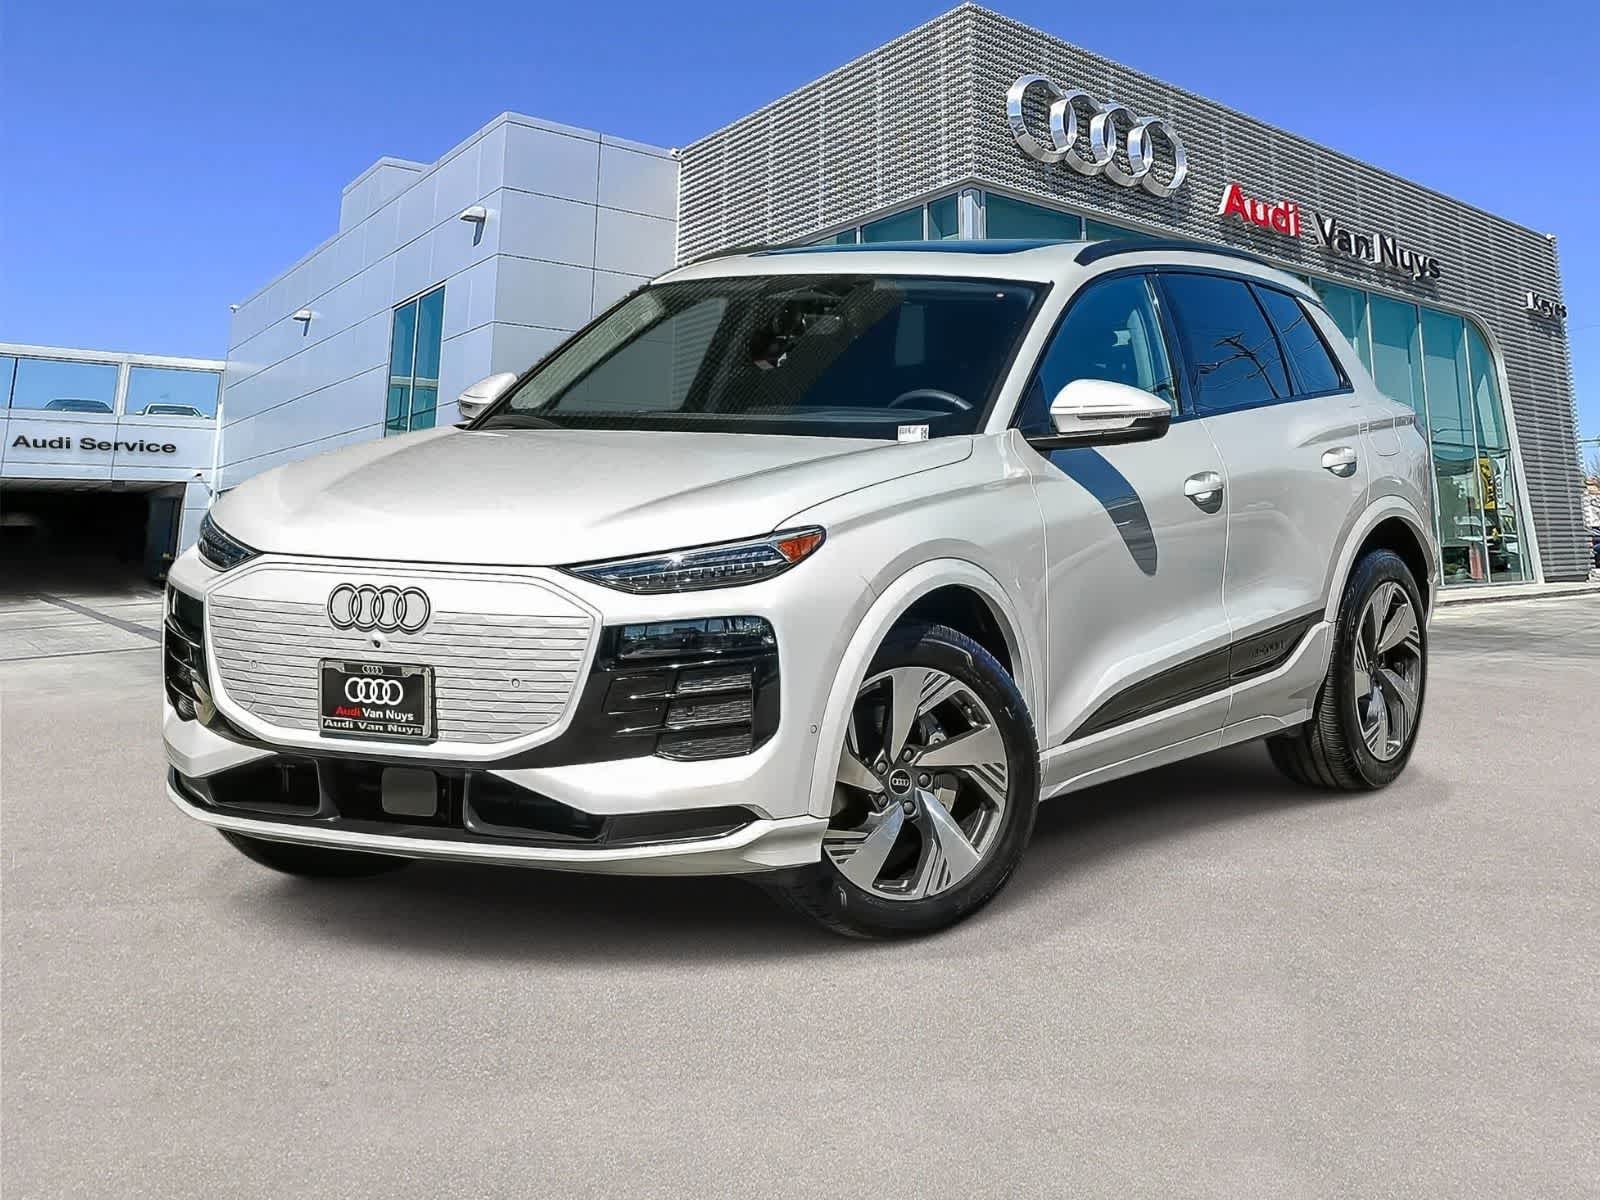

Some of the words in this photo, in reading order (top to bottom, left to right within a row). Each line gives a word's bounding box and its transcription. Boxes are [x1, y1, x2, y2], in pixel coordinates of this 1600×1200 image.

[1218, 183, 1301, 239] Audi
[1311, 213, 1371, 259] Van
[1374, 233, 1440, 280] Nuys
[12, 434, 71, 449] Audi
[80, 437, 177, 454] Service
[335, 705, 361, 717] Audi
[362, 707, 383, 718] Van
[385, 710, 414, 722] Nuys
[324, 719, 354, 730] Audi
[358, 722, 384, 732] Van
[387, 724, 423, 735] Nuys
